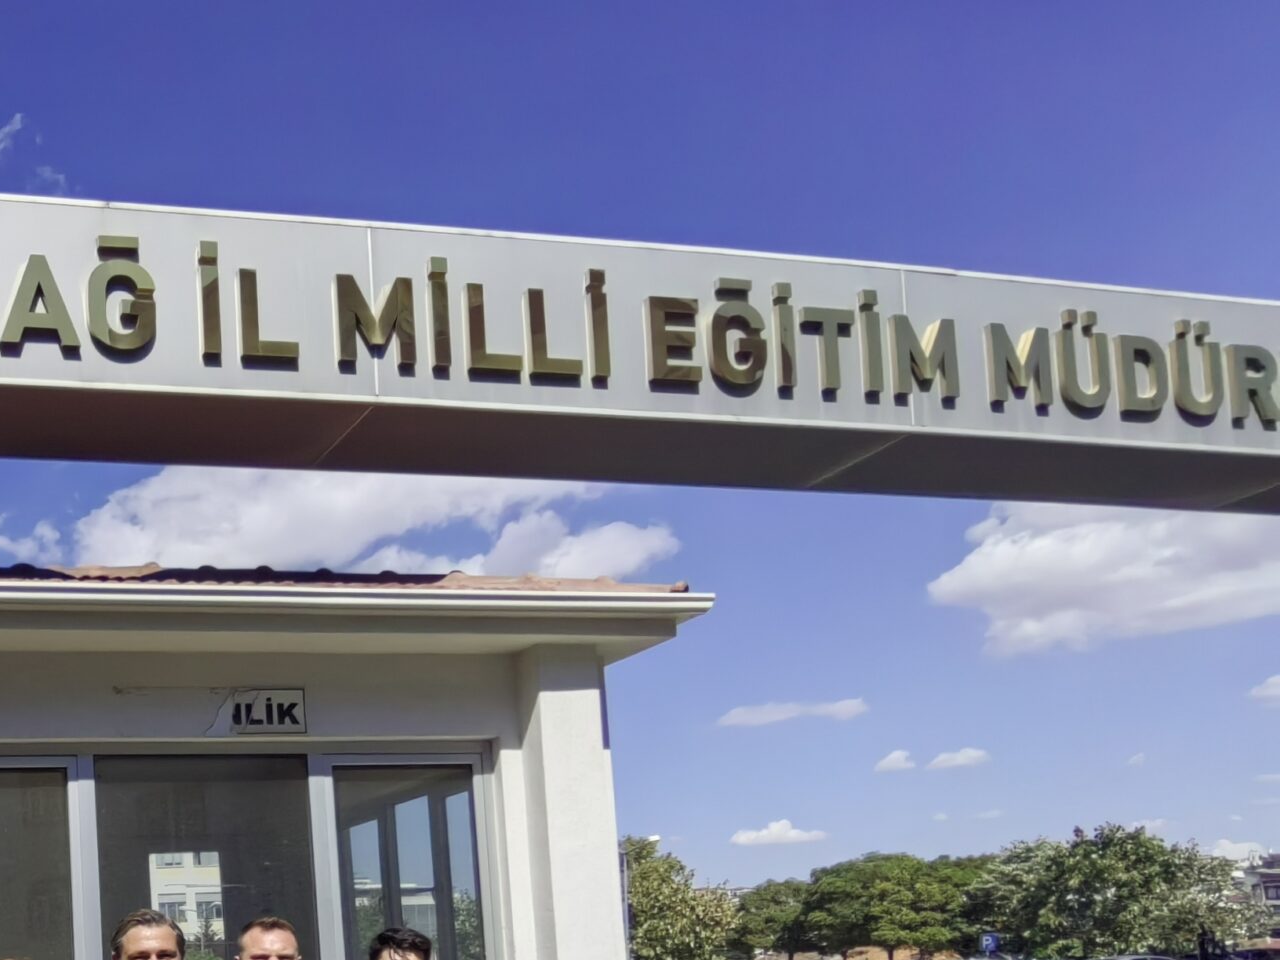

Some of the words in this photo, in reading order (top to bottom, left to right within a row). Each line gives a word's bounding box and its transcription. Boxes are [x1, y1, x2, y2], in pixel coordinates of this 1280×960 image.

[196, 240, 300, 370] İL
[332, 256, 612, 389] MİLLİ
[642, 278, 960, 404] EĞİTİM
[982, 936, 992, 949] P
